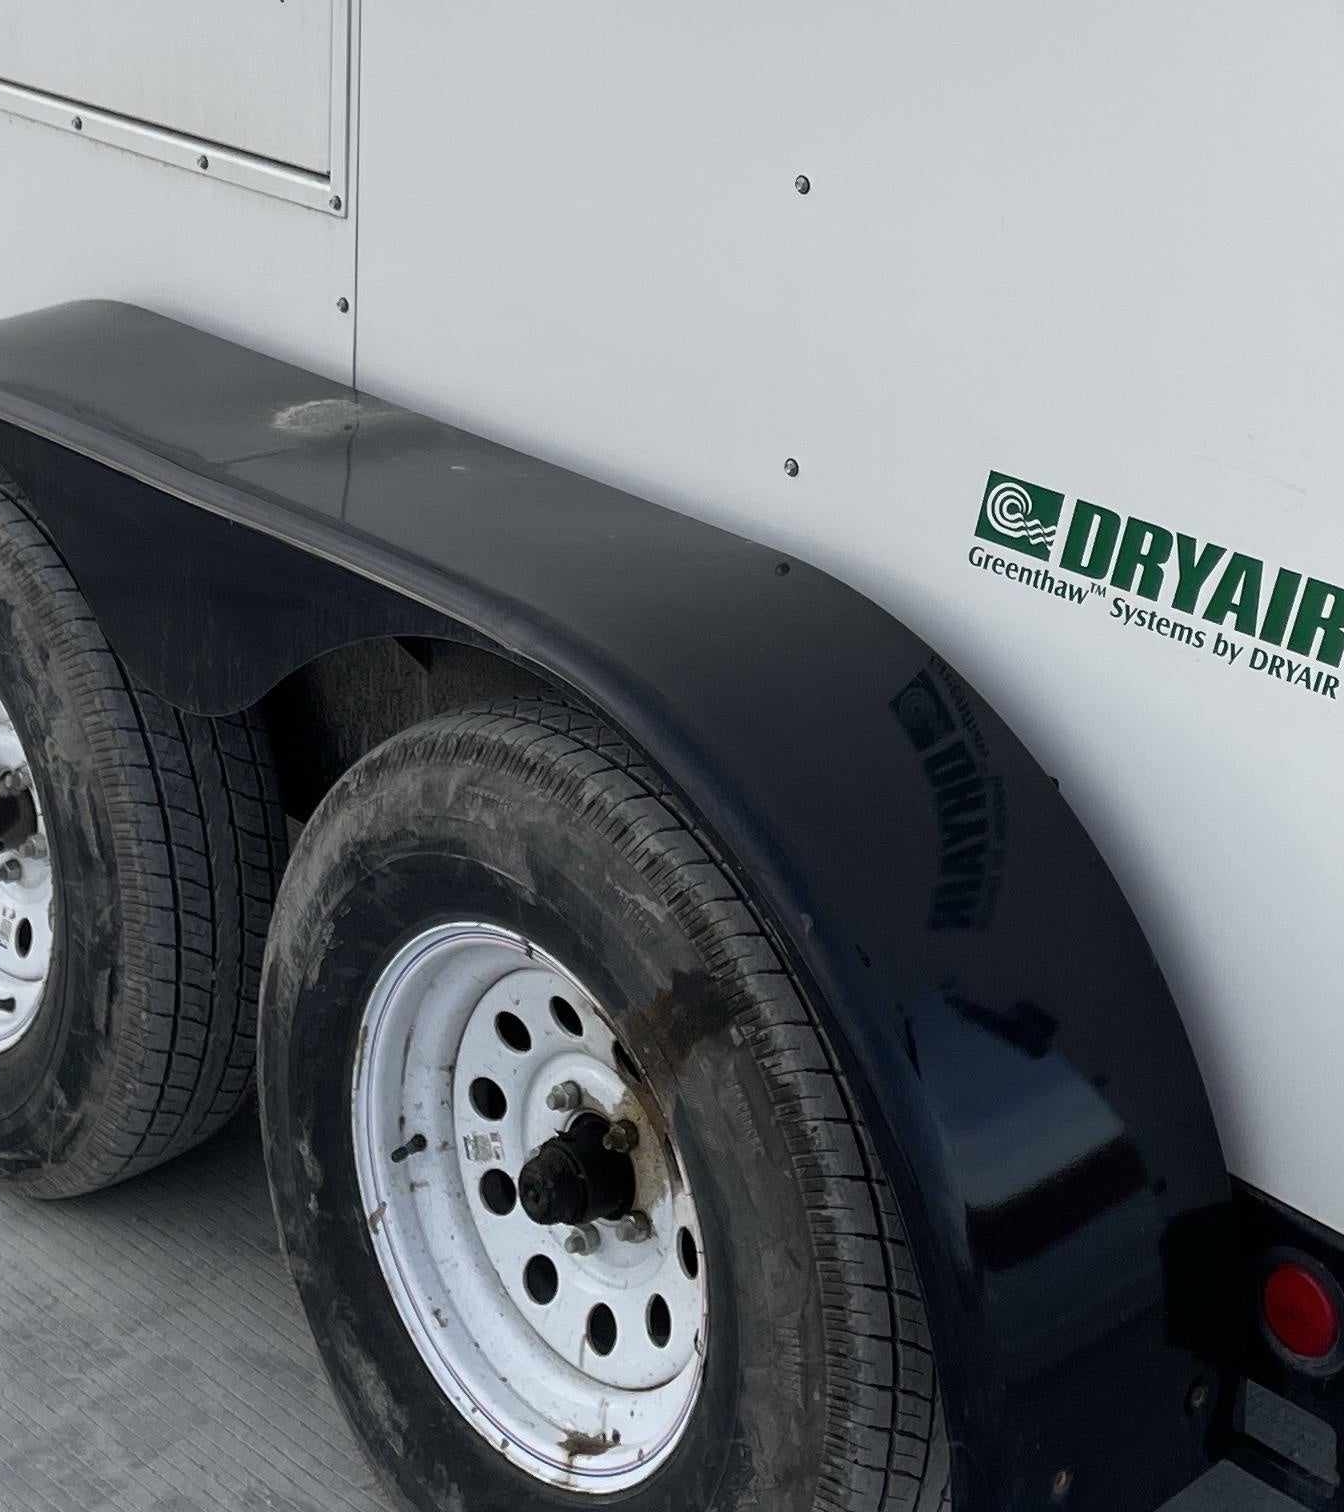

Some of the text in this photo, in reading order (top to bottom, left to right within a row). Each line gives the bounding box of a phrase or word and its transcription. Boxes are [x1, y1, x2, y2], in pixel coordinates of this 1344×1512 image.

[1109, 596, 1207, 650] Systems
[1212, 633, 1244, 666] by
[1248, 646, 1341, 700] DRYAIR
